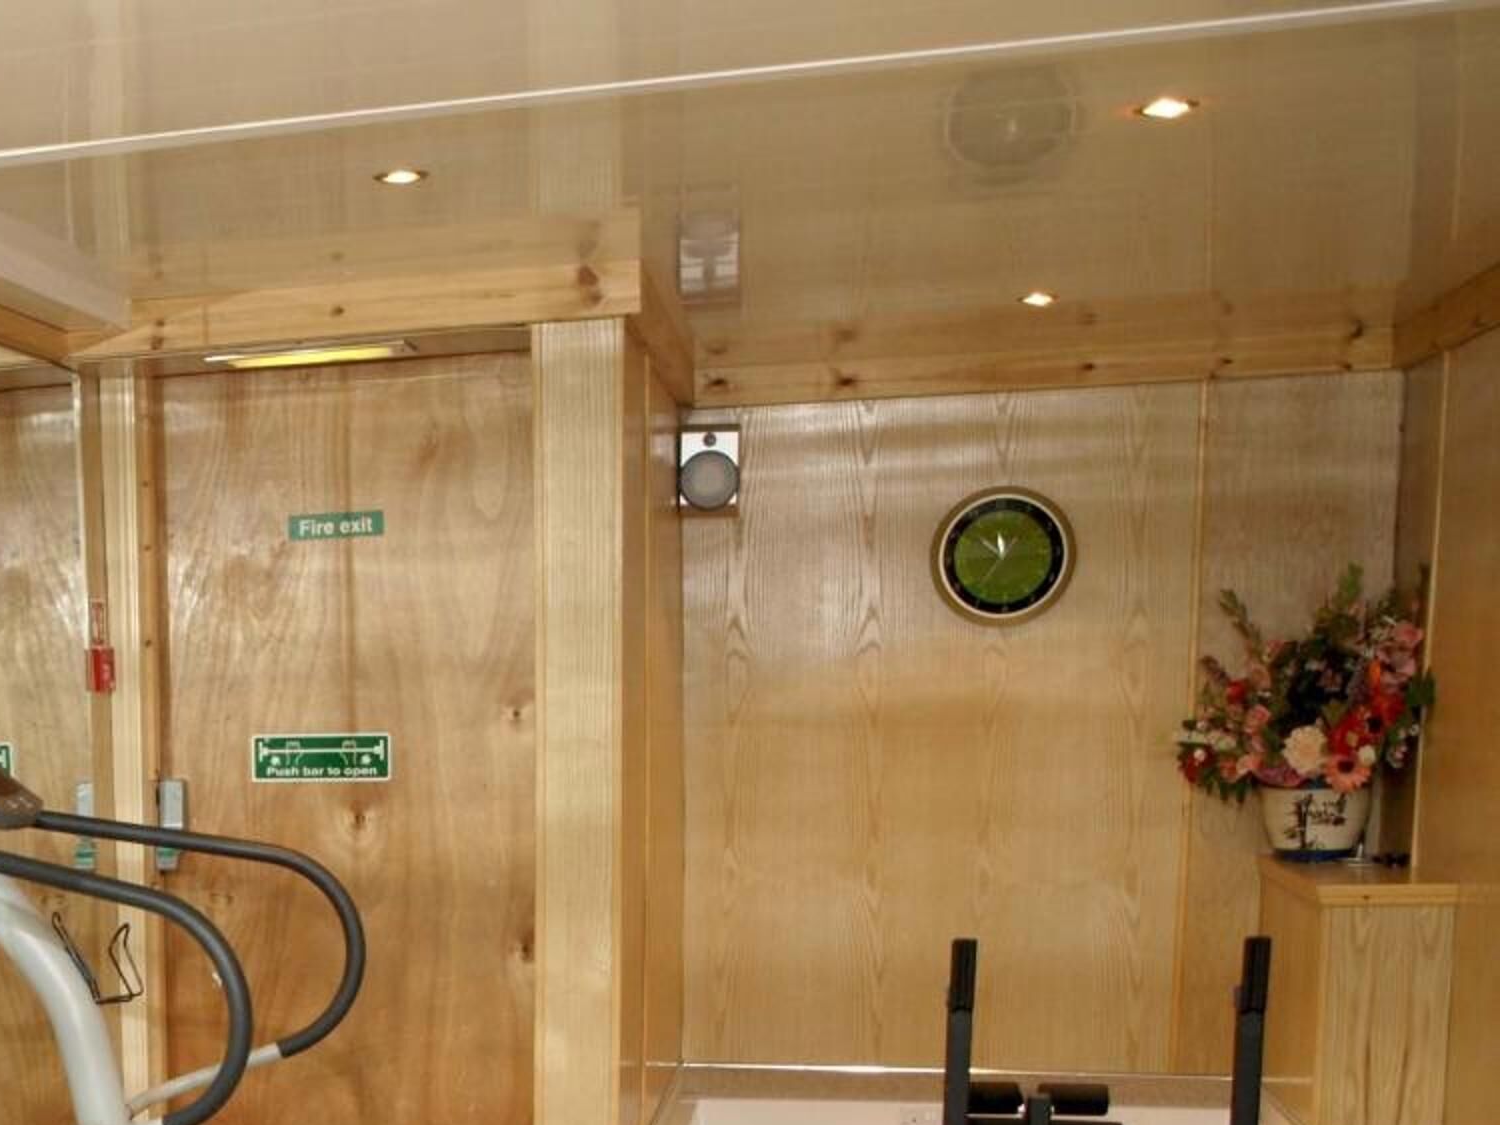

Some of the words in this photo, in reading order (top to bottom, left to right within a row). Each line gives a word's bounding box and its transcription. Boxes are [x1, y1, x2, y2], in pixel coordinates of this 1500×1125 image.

[299, 519, 334, 537] Fire
[340, 516, 373, 534] exit
[266, 767, 299, 777] Push
[303, 767, 324, 777] bar
[327, 767, 341, 777] to
[343, 767, 378, 778] open
